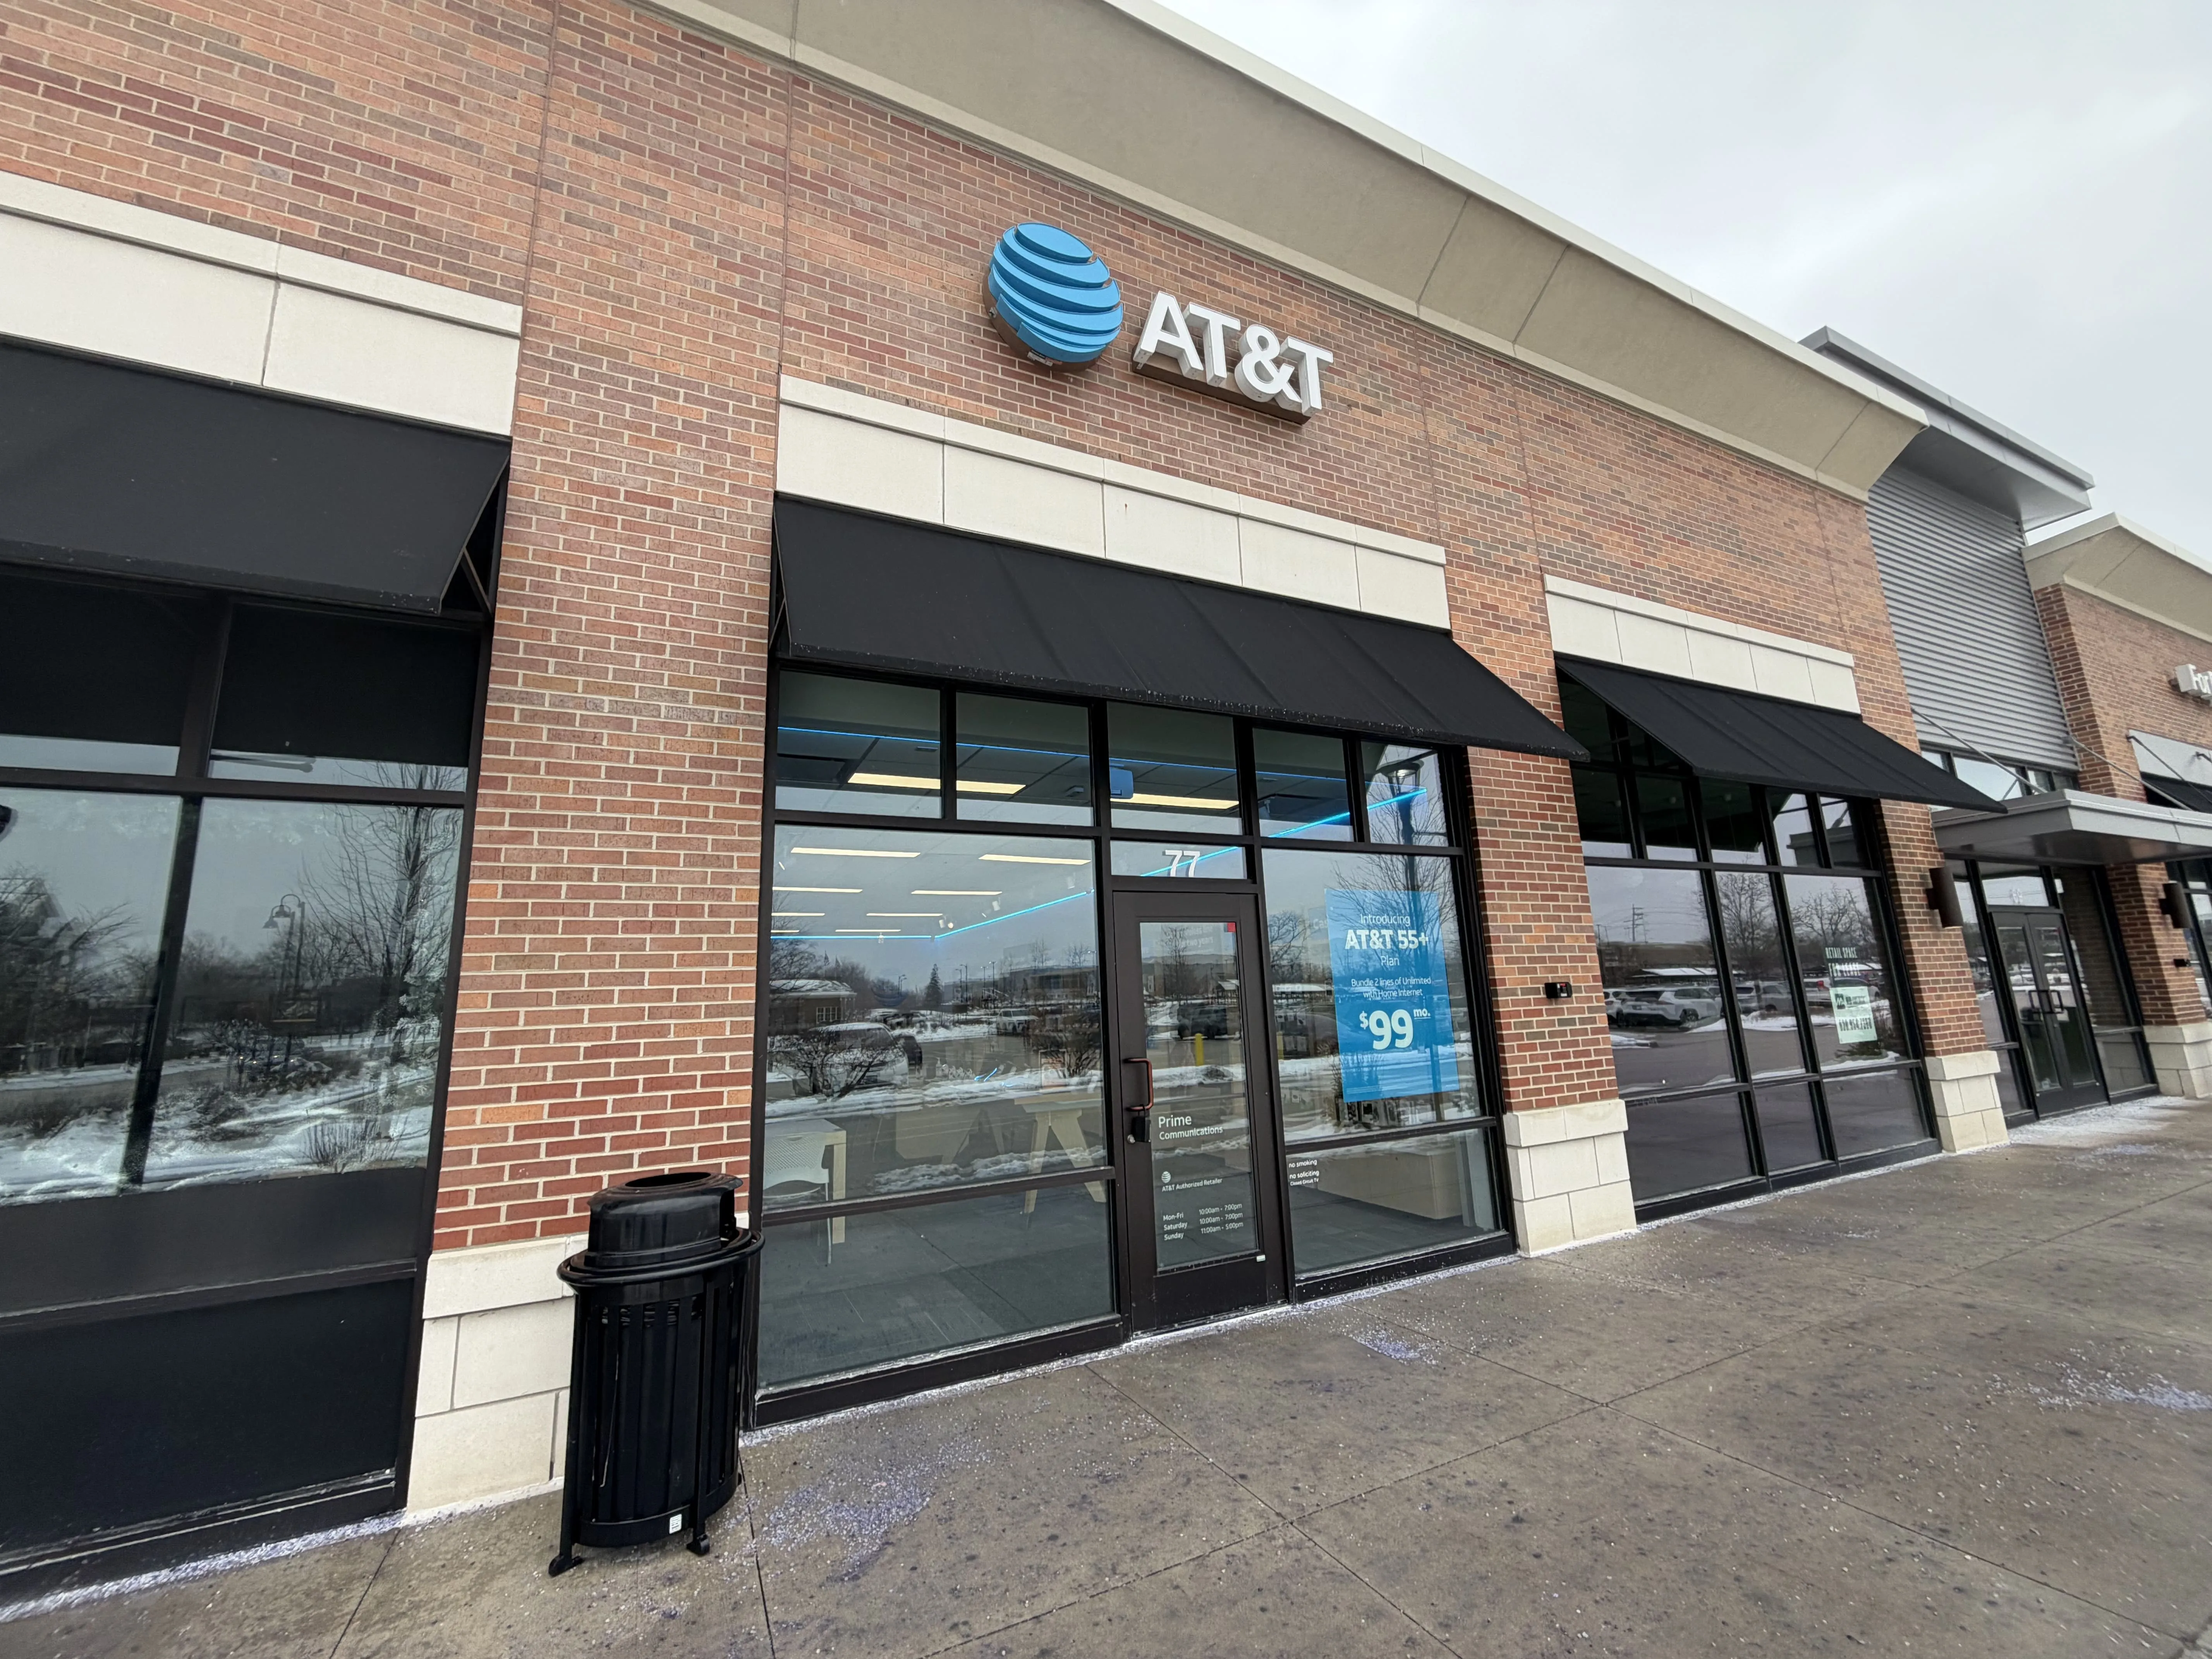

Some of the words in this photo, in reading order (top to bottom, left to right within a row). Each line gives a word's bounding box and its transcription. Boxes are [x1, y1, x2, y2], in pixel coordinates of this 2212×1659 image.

[1133, 291, 1334, 416] AT&T
[1165, 850, 1200, 877] 77
[1360, 914, 1410, 927] Introducing
[1345, 929, 1393, 949] AT&T
[1398, 930, 1429, 949] 55+
[1825, 947, 1843, 959] RETAIL
[1842, 947, 1858, 958] SPACE
[1381, 955, 1400, 966] Plan
[1828, 963, 1841, 977] FOR
[1351, 978, 1374, 987] Bundle
[1379, 978, 1394, 986] lines
[1402, 976, 1431, 985] Unlimited
[1363, 989, 1377, 998] with
[1359, 1009, 1413, 1050] $99
[1413, 1008, 1431, 1017] mo.
[1158, 1115, 1192, 1128] Prime
[1159, 1126, 1223, 1140] Communications
[1297, 1159, 1317, 1167] smoking
[1297, 1170, 1319, 1178] soliciting
[1176, 1180, 1203, 1190] Authorized
[1163, 1212, 1184, 1221] Mon-Fri
[1199, 1207, 1219, 1215] 10:00am
[1164, 1222, 1188, 1231] Saturday
[1200, 1217, 1220, 1225] 10:00am
[1164, 1232, 1184, 1241] Sunday
[1226, 1222, 1243, 1230] 5:00pm
